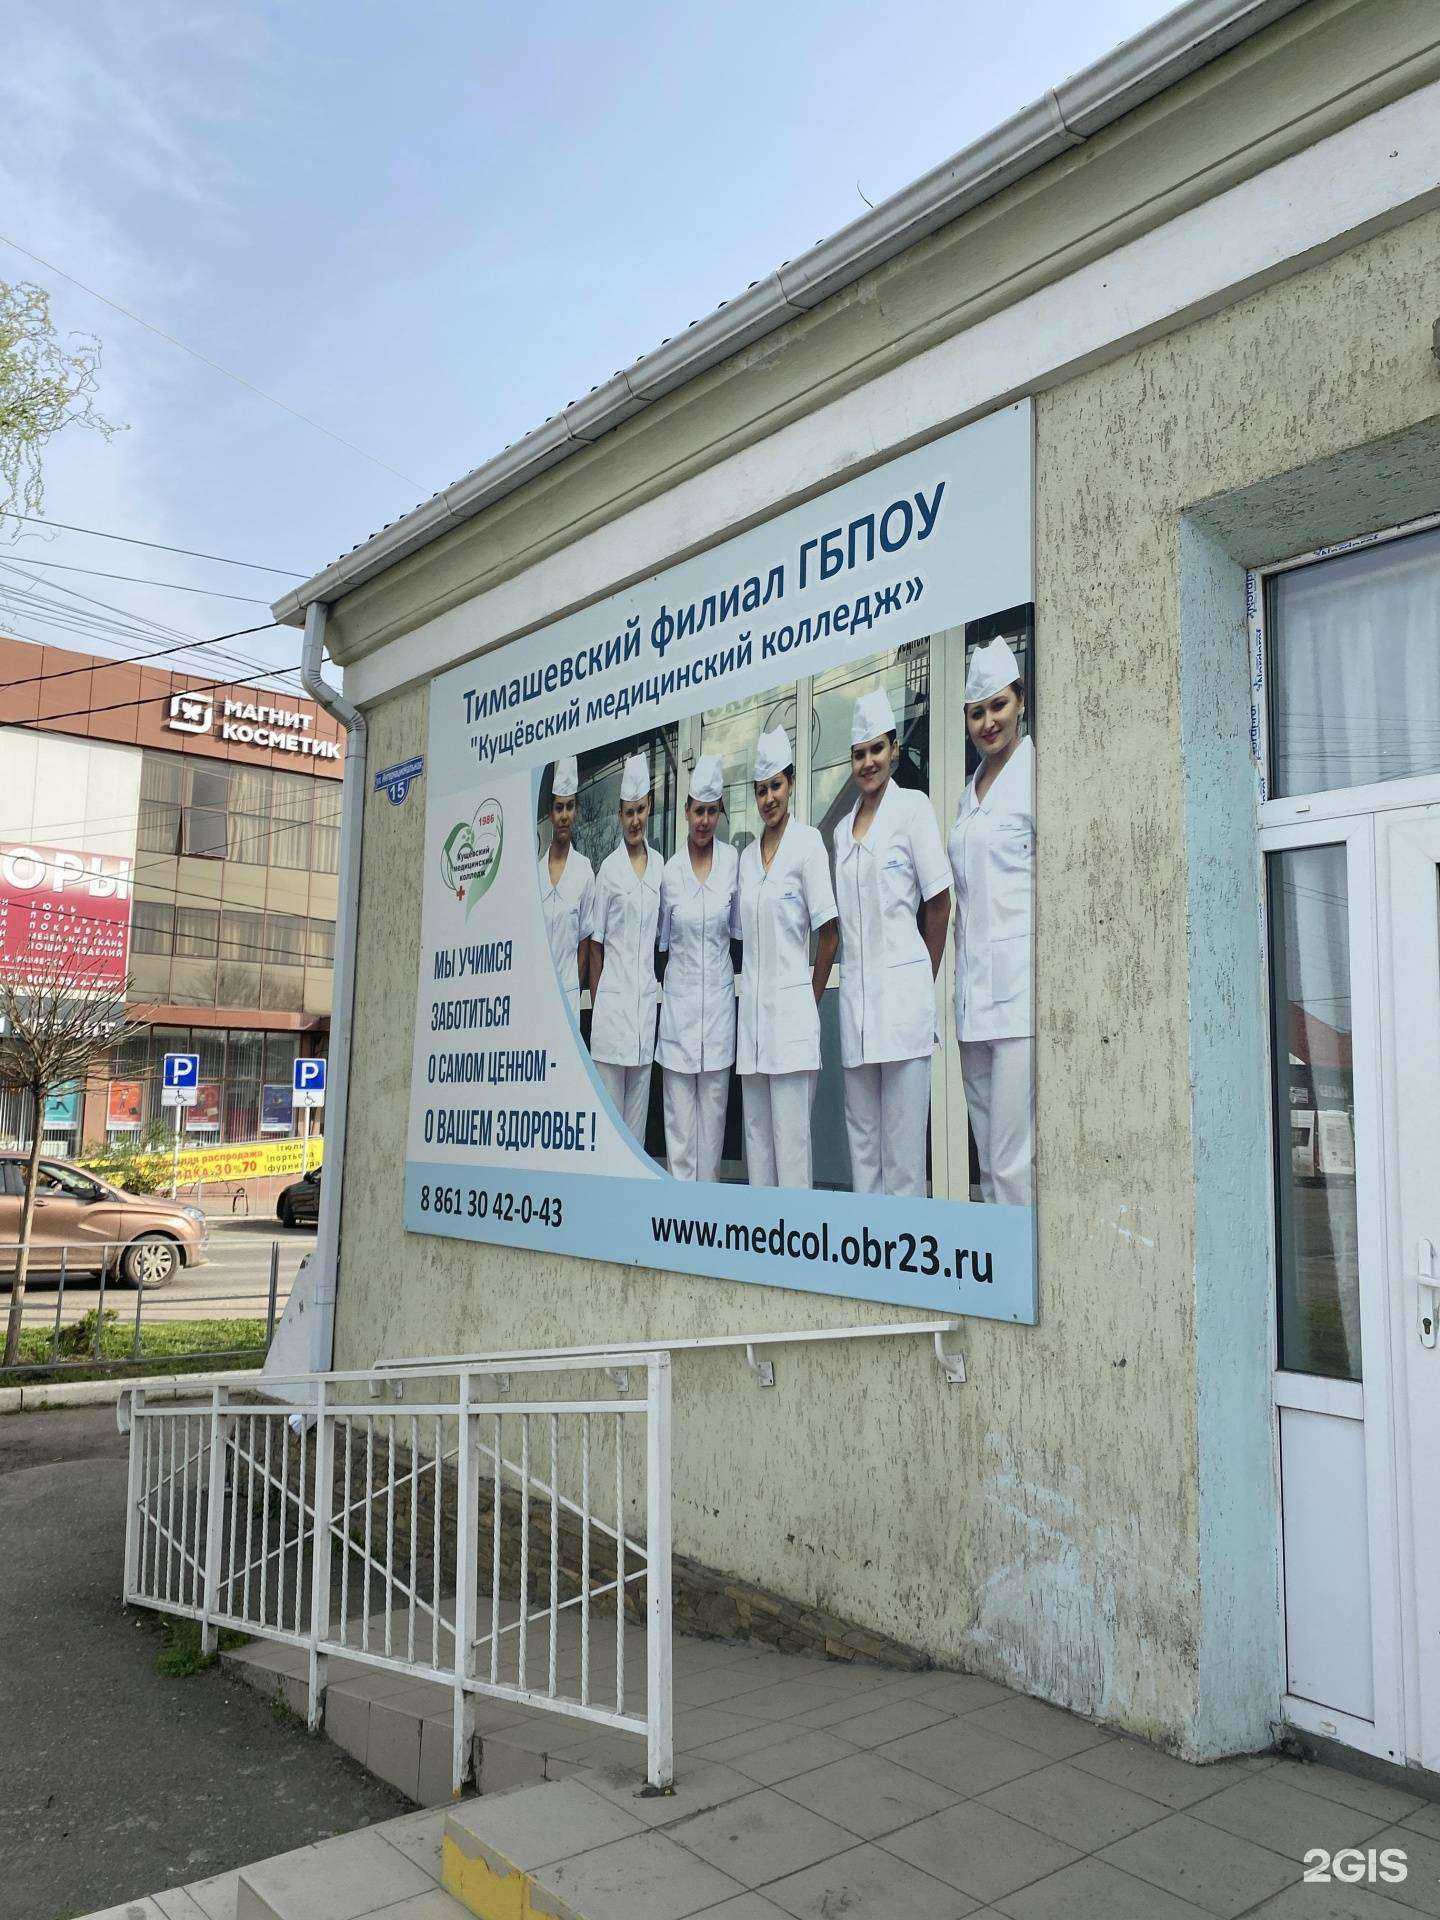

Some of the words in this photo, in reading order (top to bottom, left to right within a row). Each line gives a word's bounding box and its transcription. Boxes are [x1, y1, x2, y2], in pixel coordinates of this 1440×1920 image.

[463, 615, 640, 724] Тимашевский
[651, 565, 784, 657] филиал
[799, 481, 945, 590] ГБПОУ
[470, 697, 580, 764] "Кущёвский
[586, 631, 752, 720] медицинский
[762, 576, 924, 660] колледж»
[224, 696, 314, 730] МАГНИТ
[222, 722, 342, 760] КОСМЕТИК
[390, 781, 405, 801] 15
[1, 846, 130, 900] ОРЫ
[30, 900, 77, 913] ТЮЛЬ
[29, 921, 124, 938] ПОКРЫВАЛА
[93, 937, 124, 948] ТКАНЬ
[73, 946, 123, 958] ИЗДЕЛИЙ
[434, 949, 455, 979] МЫ
[458, 940, 513, 977] УЧИМСЯ
[431, 995, 511, 1031] ЗАБОТИТЬСЯ
[427, 1053, 436, 1083] О
[438, 1051, 485, 1083] САМОМ
[487, 1049, 547, 1086] ЦЕННОМ
[424, 1109, 433, 1144] О
[436, 1109, 492, 1146] ВАШЕМ
[420, 1184, 430, 1211] 8
[434, 1186, 462, 1216] 861
[467, 1189, 488, 1218] 30
[492, 1192, 563, 1228] 42-0-43
[651, 1216, 994, 1284] www.medcol.obr23.ru
